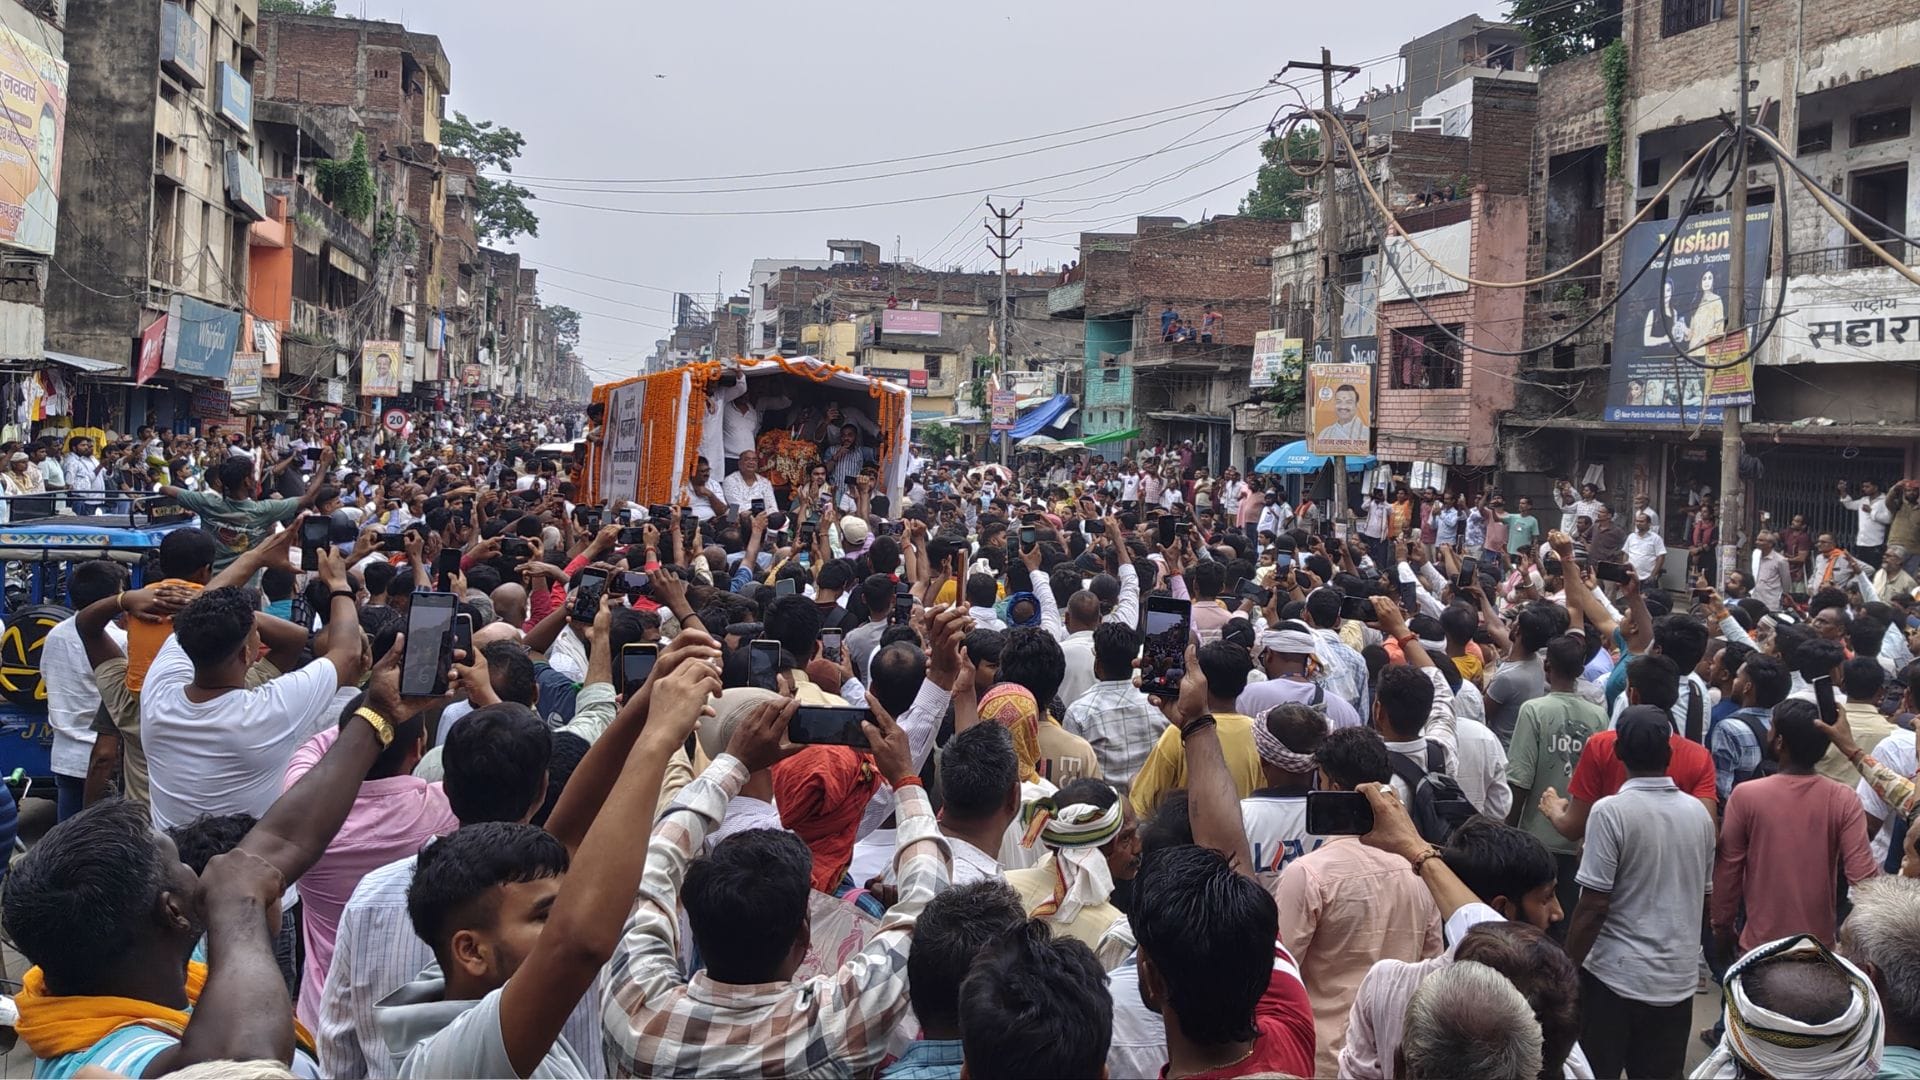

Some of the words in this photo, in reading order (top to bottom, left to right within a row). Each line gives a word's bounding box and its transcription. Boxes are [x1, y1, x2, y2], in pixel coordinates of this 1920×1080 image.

[1703, 252, 1731, 264] Academ
[1808, 315, 1920, 349] सहार
[389, 415, 403, 425] 20
[1548, 734, 1582, 753] JORD
